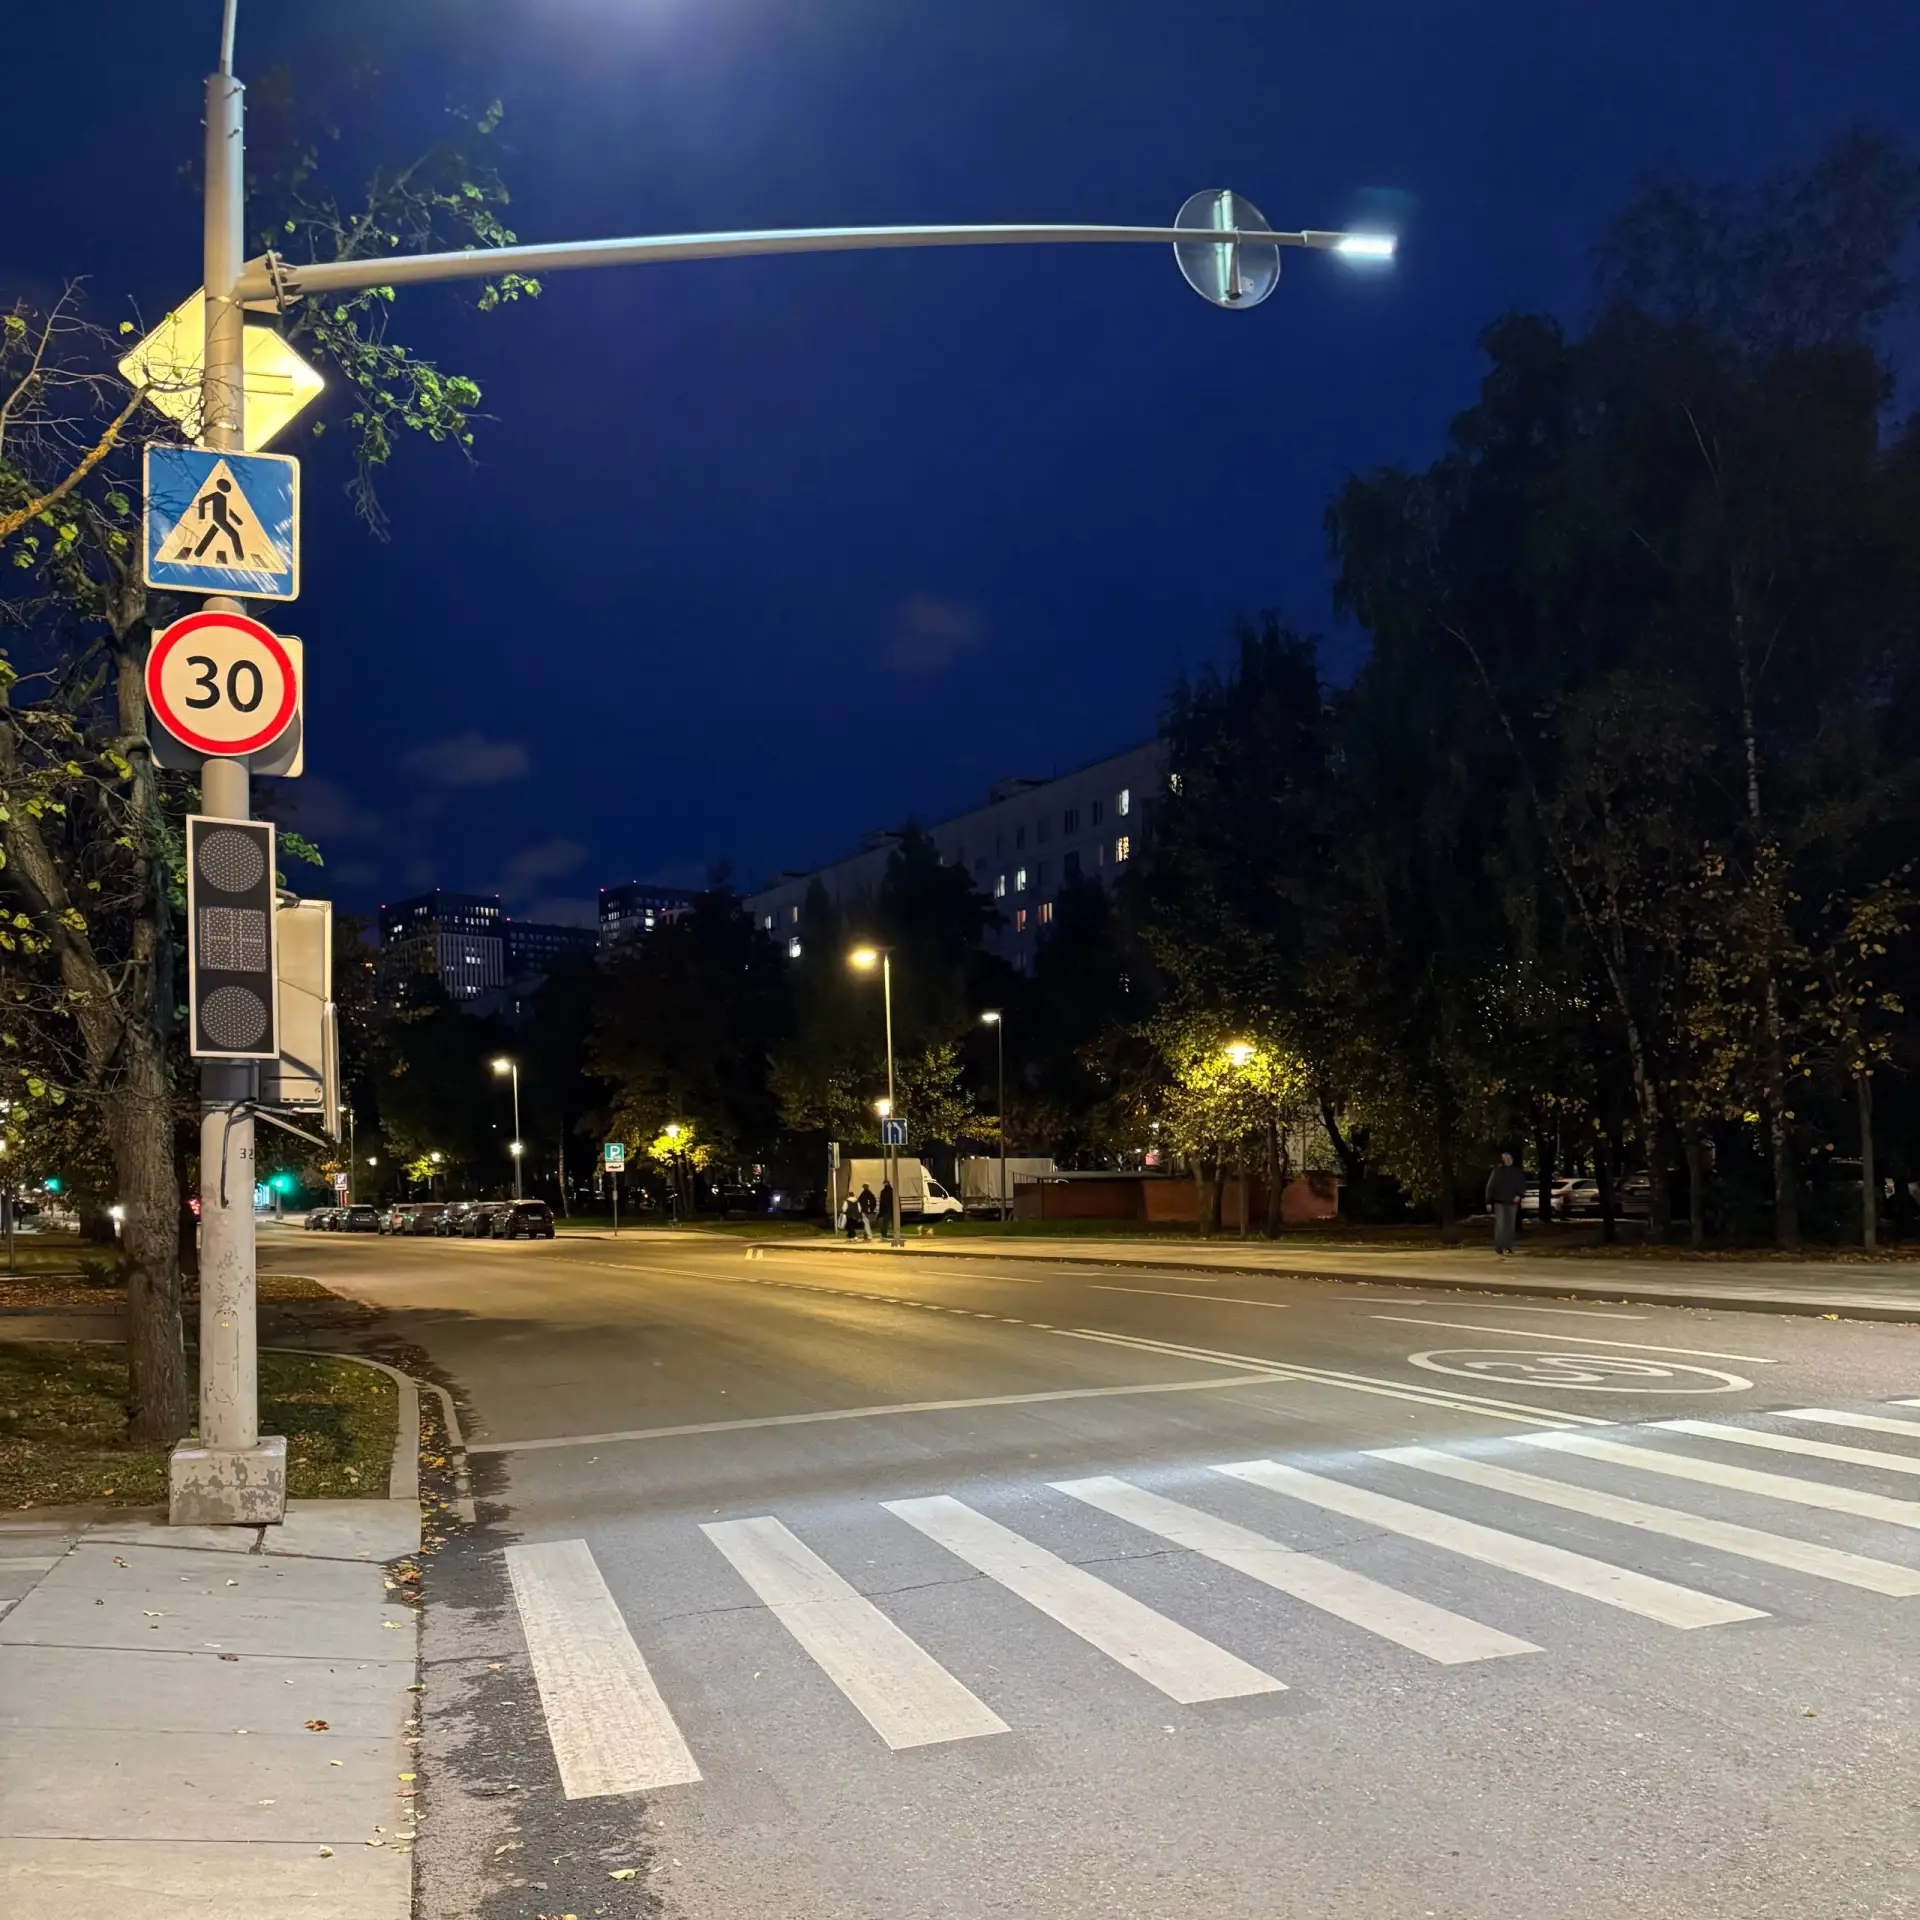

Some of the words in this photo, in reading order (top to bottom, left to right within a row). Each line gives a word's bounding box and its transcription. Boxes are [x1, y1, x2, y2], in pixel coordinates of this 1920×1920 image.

[185, 655, 264, 713] 30
[609, 1145, 621, 1159] P
[1463, 1357, 1675, 1382] 30
